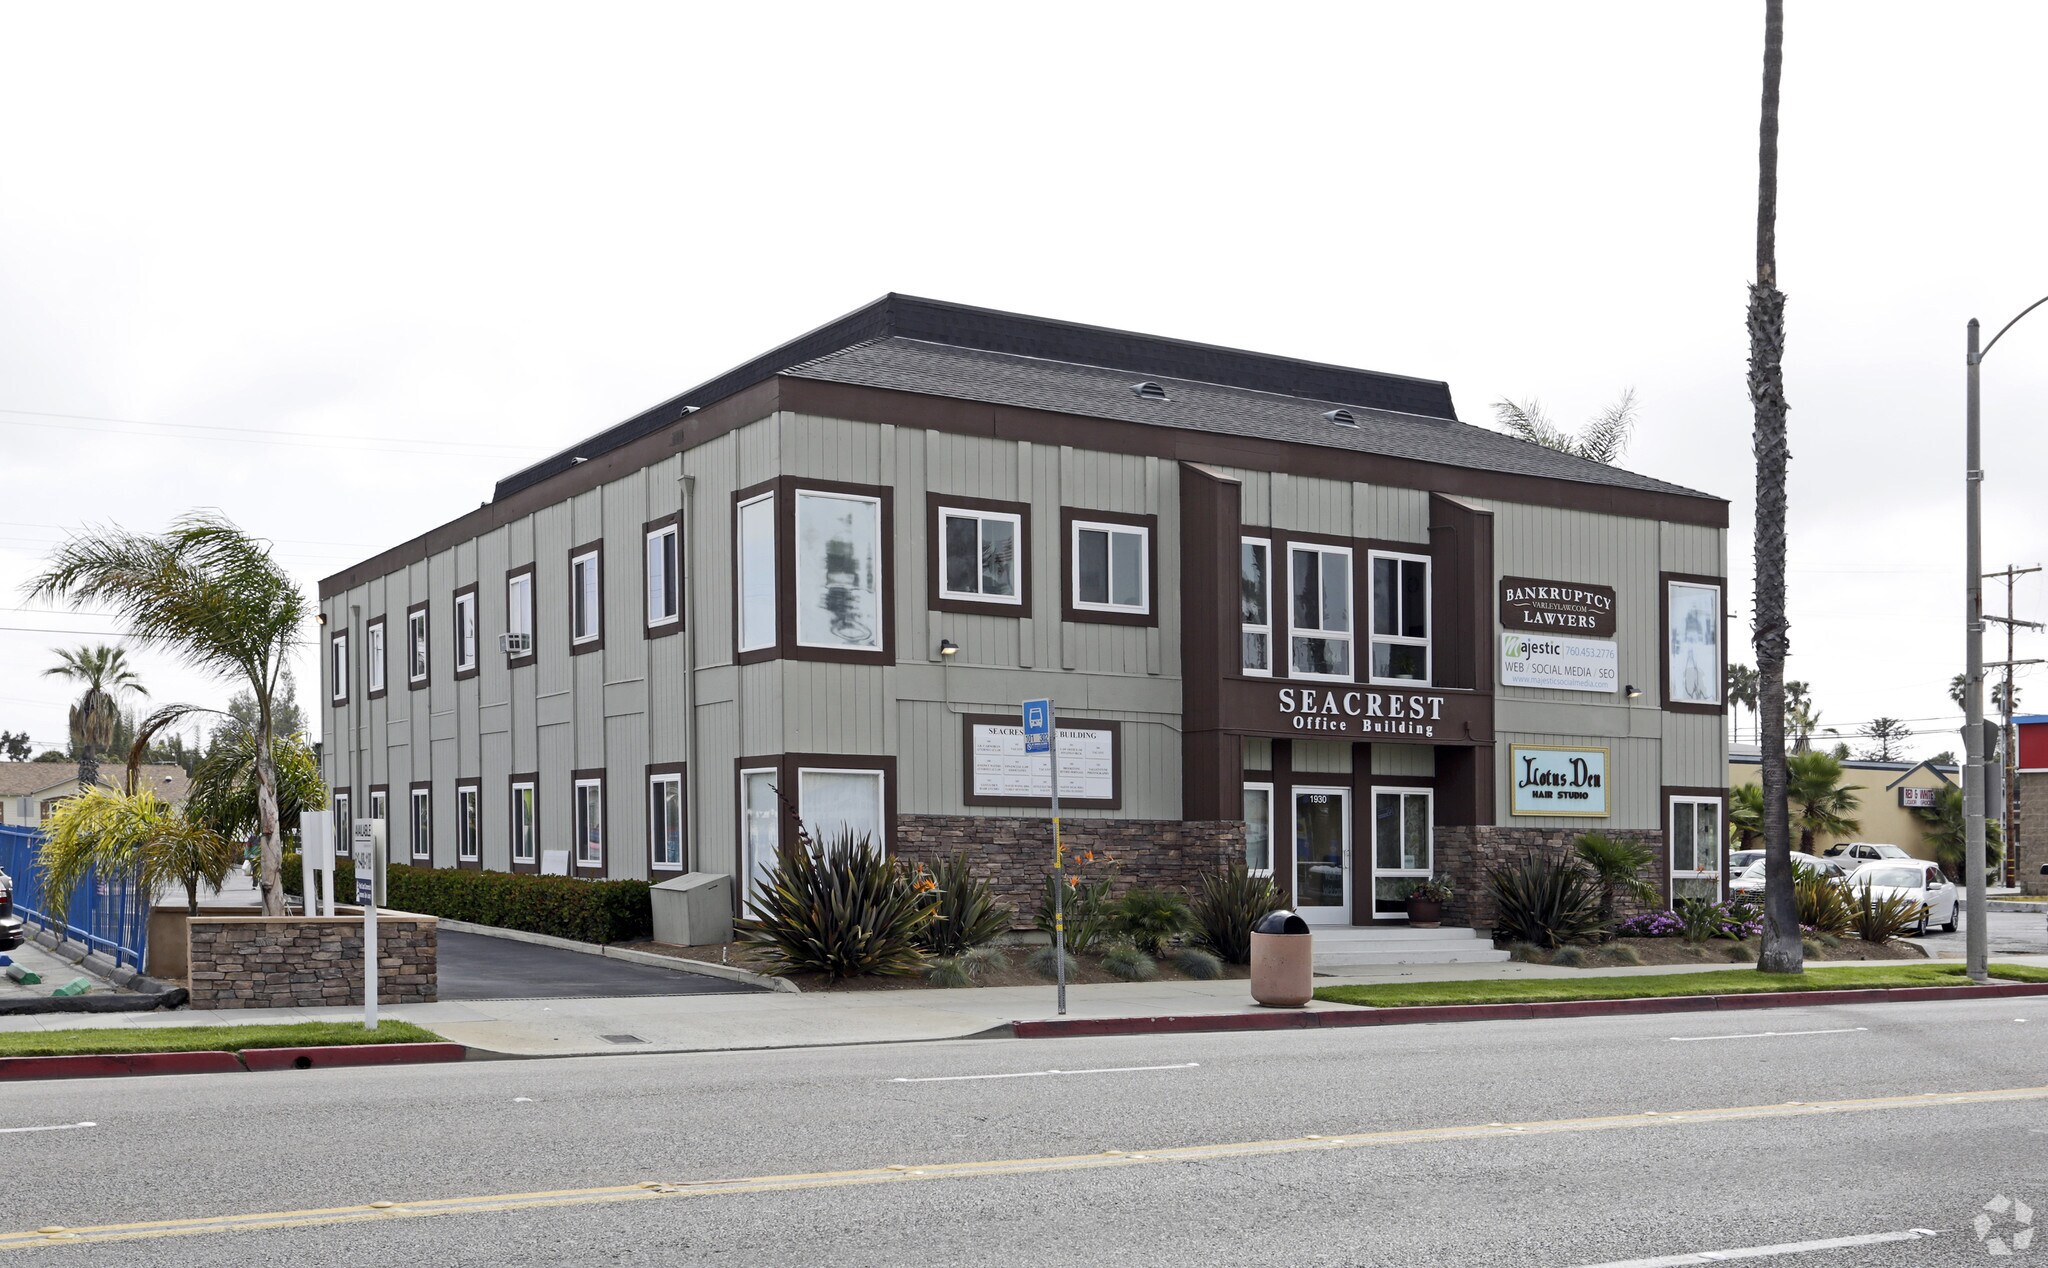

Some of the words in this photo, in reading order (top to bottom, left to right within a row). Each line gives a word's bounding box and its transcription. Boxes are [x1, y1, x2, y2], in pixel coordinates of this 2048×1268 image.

[1506, 587, 1611, 610] BANKRUPTCY
[1524, 611, 1596, 628] LAWYERS
[1565, 645, 1615, 659] 760.453.2776
[1505, 661, 1525, 673] WEB
[1532, 663, 1562, 675] SOCIAL
[1564, 666, 1592, 677] MEDIA
[1599, 668, 1615, 679] SEO
[1512, 675, 1609, 689] www.majesticsocialmedia.com
[1278, 688, 1444, 720] SEACREST
[988, 727, 1024, 736] SEACRES
[1060, 731, 1097, 739] BUILDING
[1292, 715, 1347, 731] Office
[1362, 719, 1433, 737] Building
[1519, 755, 1567, 788] Lotus
[1569, 757, 1601, 788] Den
[1309, 795, 1327, 804] 1930
[1532, 790, 1553, 799] HAIR
[1557, 791, 1589, 800] STUDIO
[1905, 789, 1913, 799] RED
[355, 824, 371, 837] AVAILABLE
